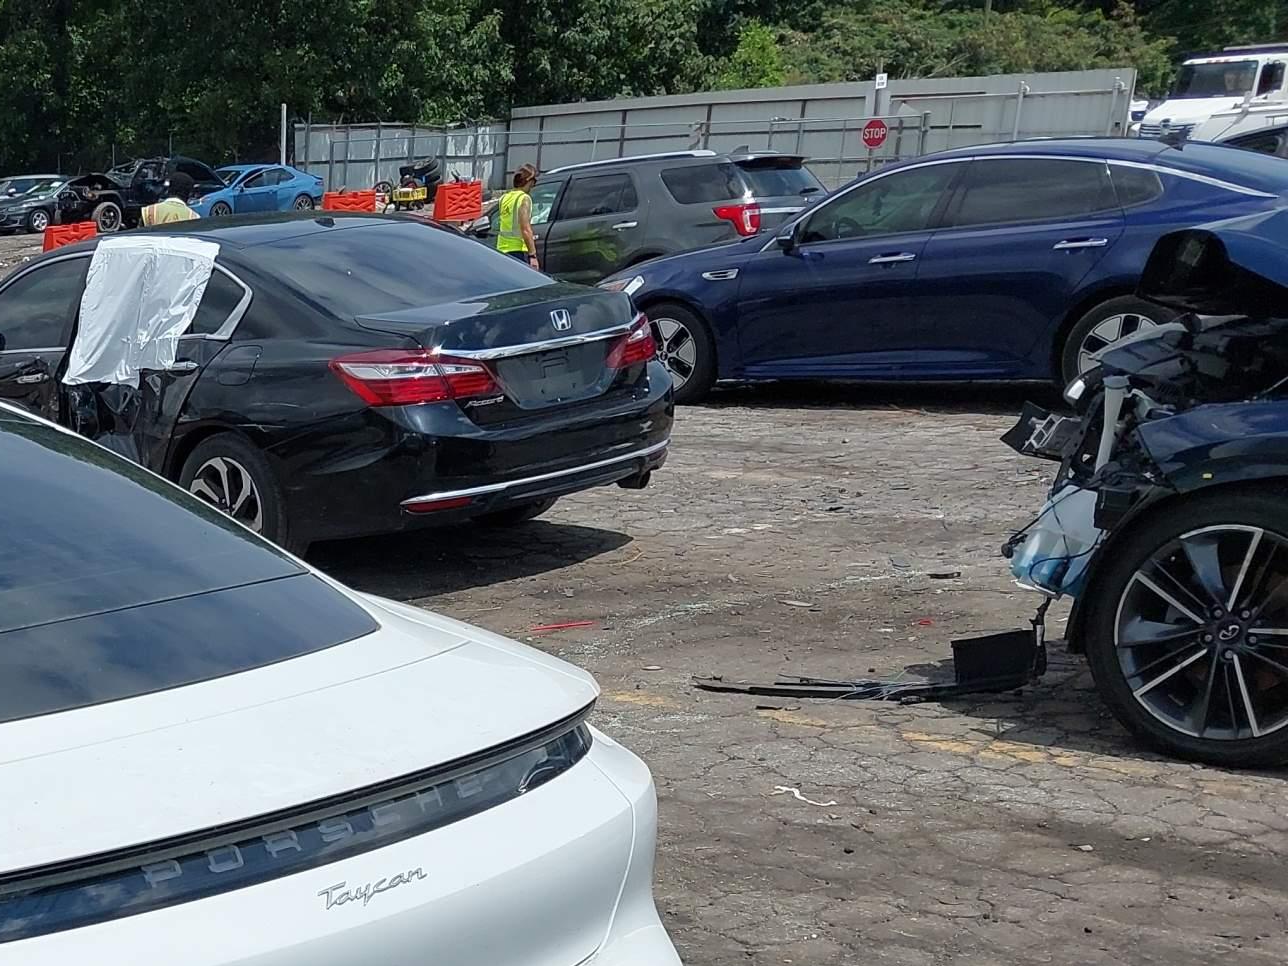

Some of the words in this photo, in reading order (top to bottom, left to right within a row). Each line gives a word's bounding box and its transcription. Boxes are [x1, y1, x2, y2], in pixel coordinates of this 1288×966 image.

[864, 127, 886, 139] STOP
[140, 776, 484, 888] PORSCHE
[318, 865, 428, 911] Taycan
